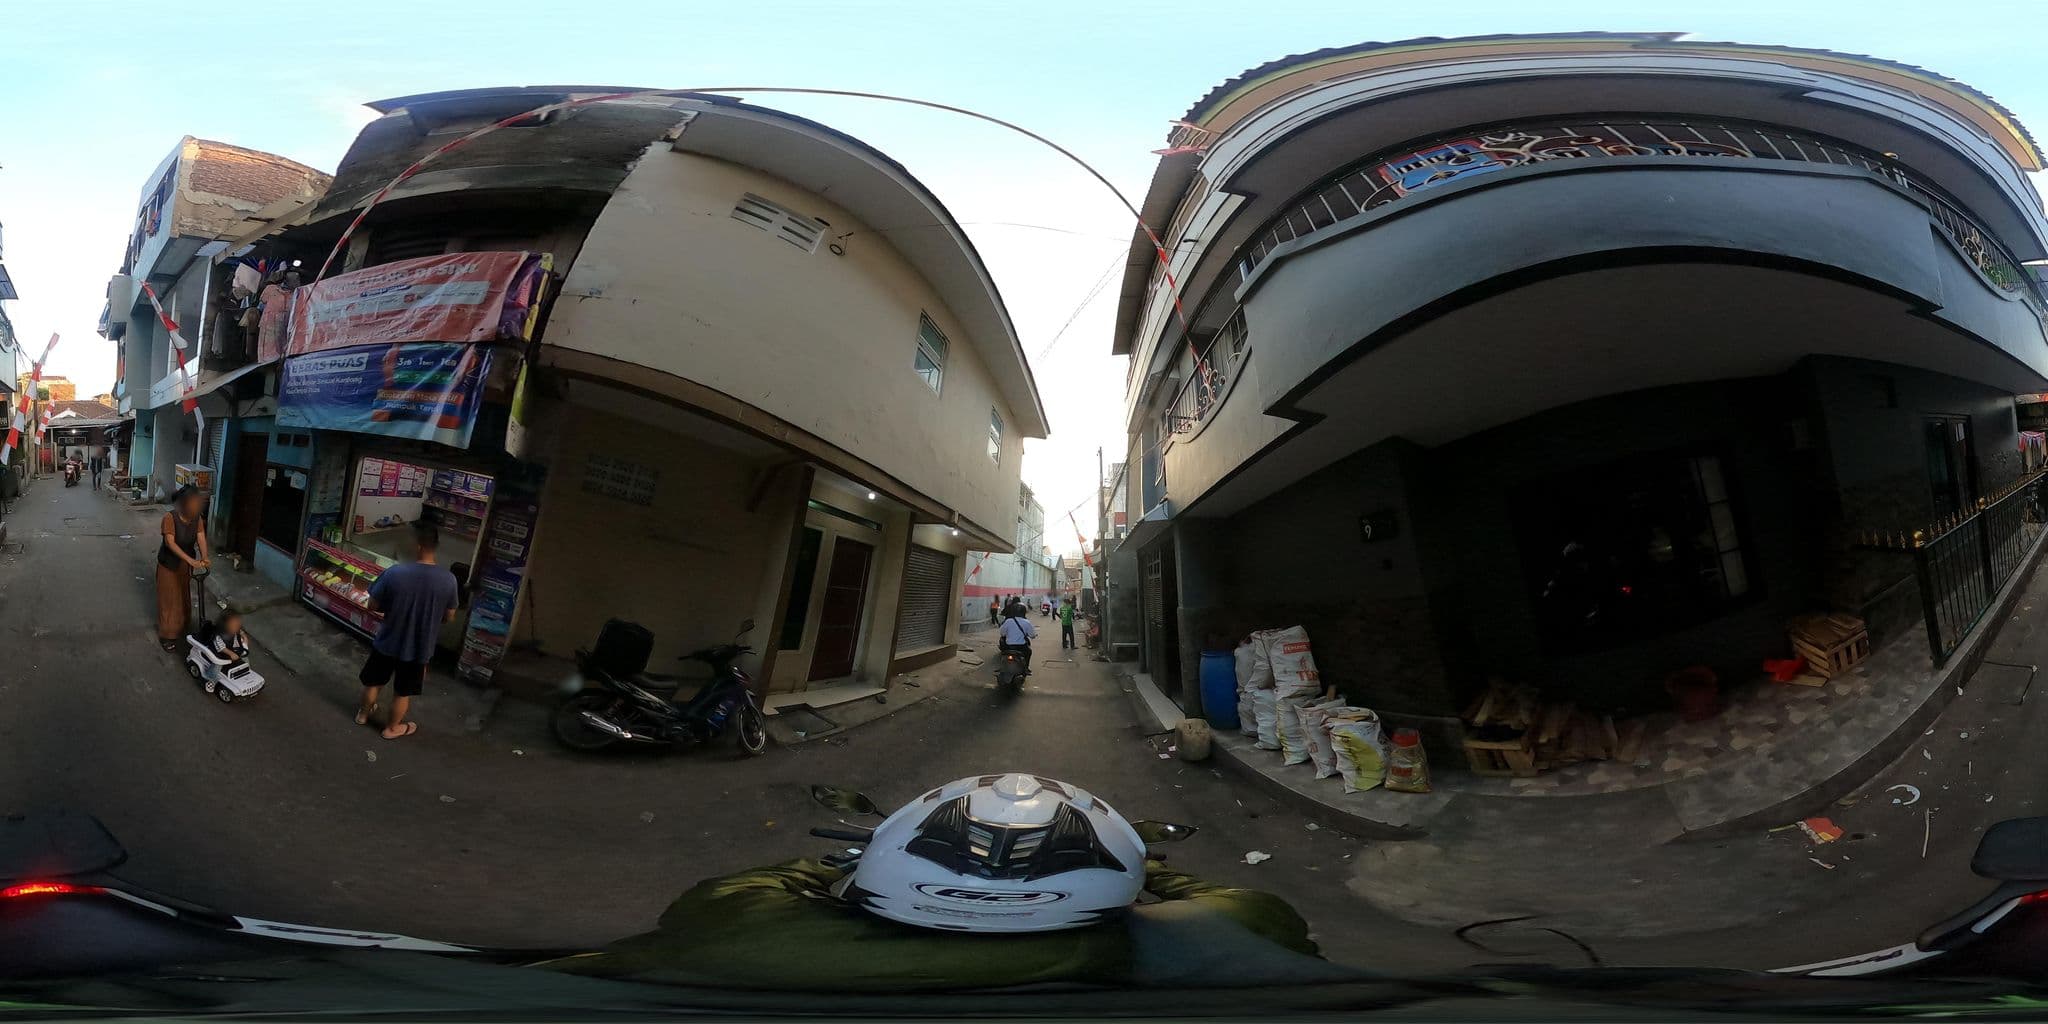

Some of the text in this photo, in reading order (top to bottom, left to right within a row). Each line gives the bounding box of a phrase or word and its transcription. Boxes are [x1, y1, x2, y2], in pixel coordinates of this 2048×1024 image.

[329, 356, 365, 369] PUAS
[1364, 524, 1372, 540] 9
[305, 584, 314, 599] 3
